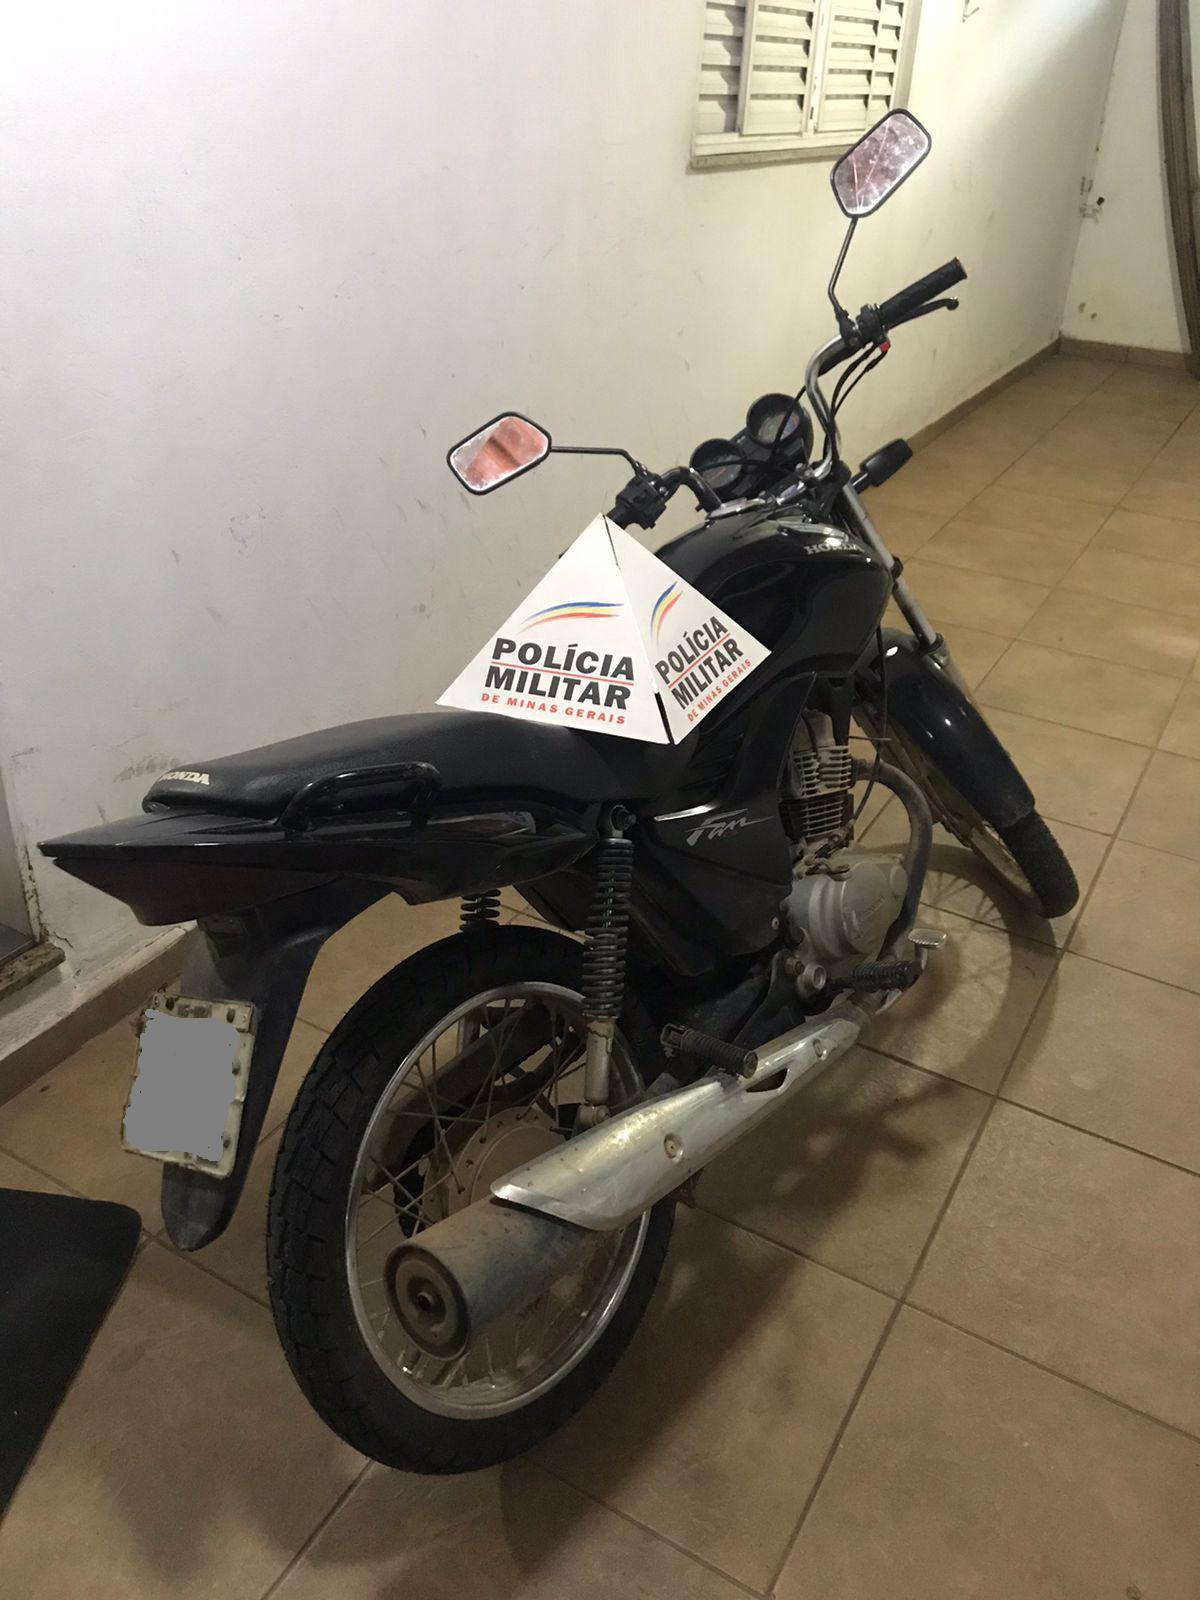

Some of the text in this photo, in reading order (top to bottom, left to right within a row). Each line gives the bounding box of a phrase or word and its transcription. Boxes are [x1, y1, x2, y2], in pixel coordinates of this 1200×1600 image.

[492, 638, 634, 681] POLÍCIA
[655, 616, 728, 685] POLÍCIA
[671, 639, 744, 710] MILITAR
[481, 693, 625, 724] DE MINAS GERAIS
[485, 666, 631, 710] MILITAR
[687, 659, 751, 722] DE MINAS GERAIS
